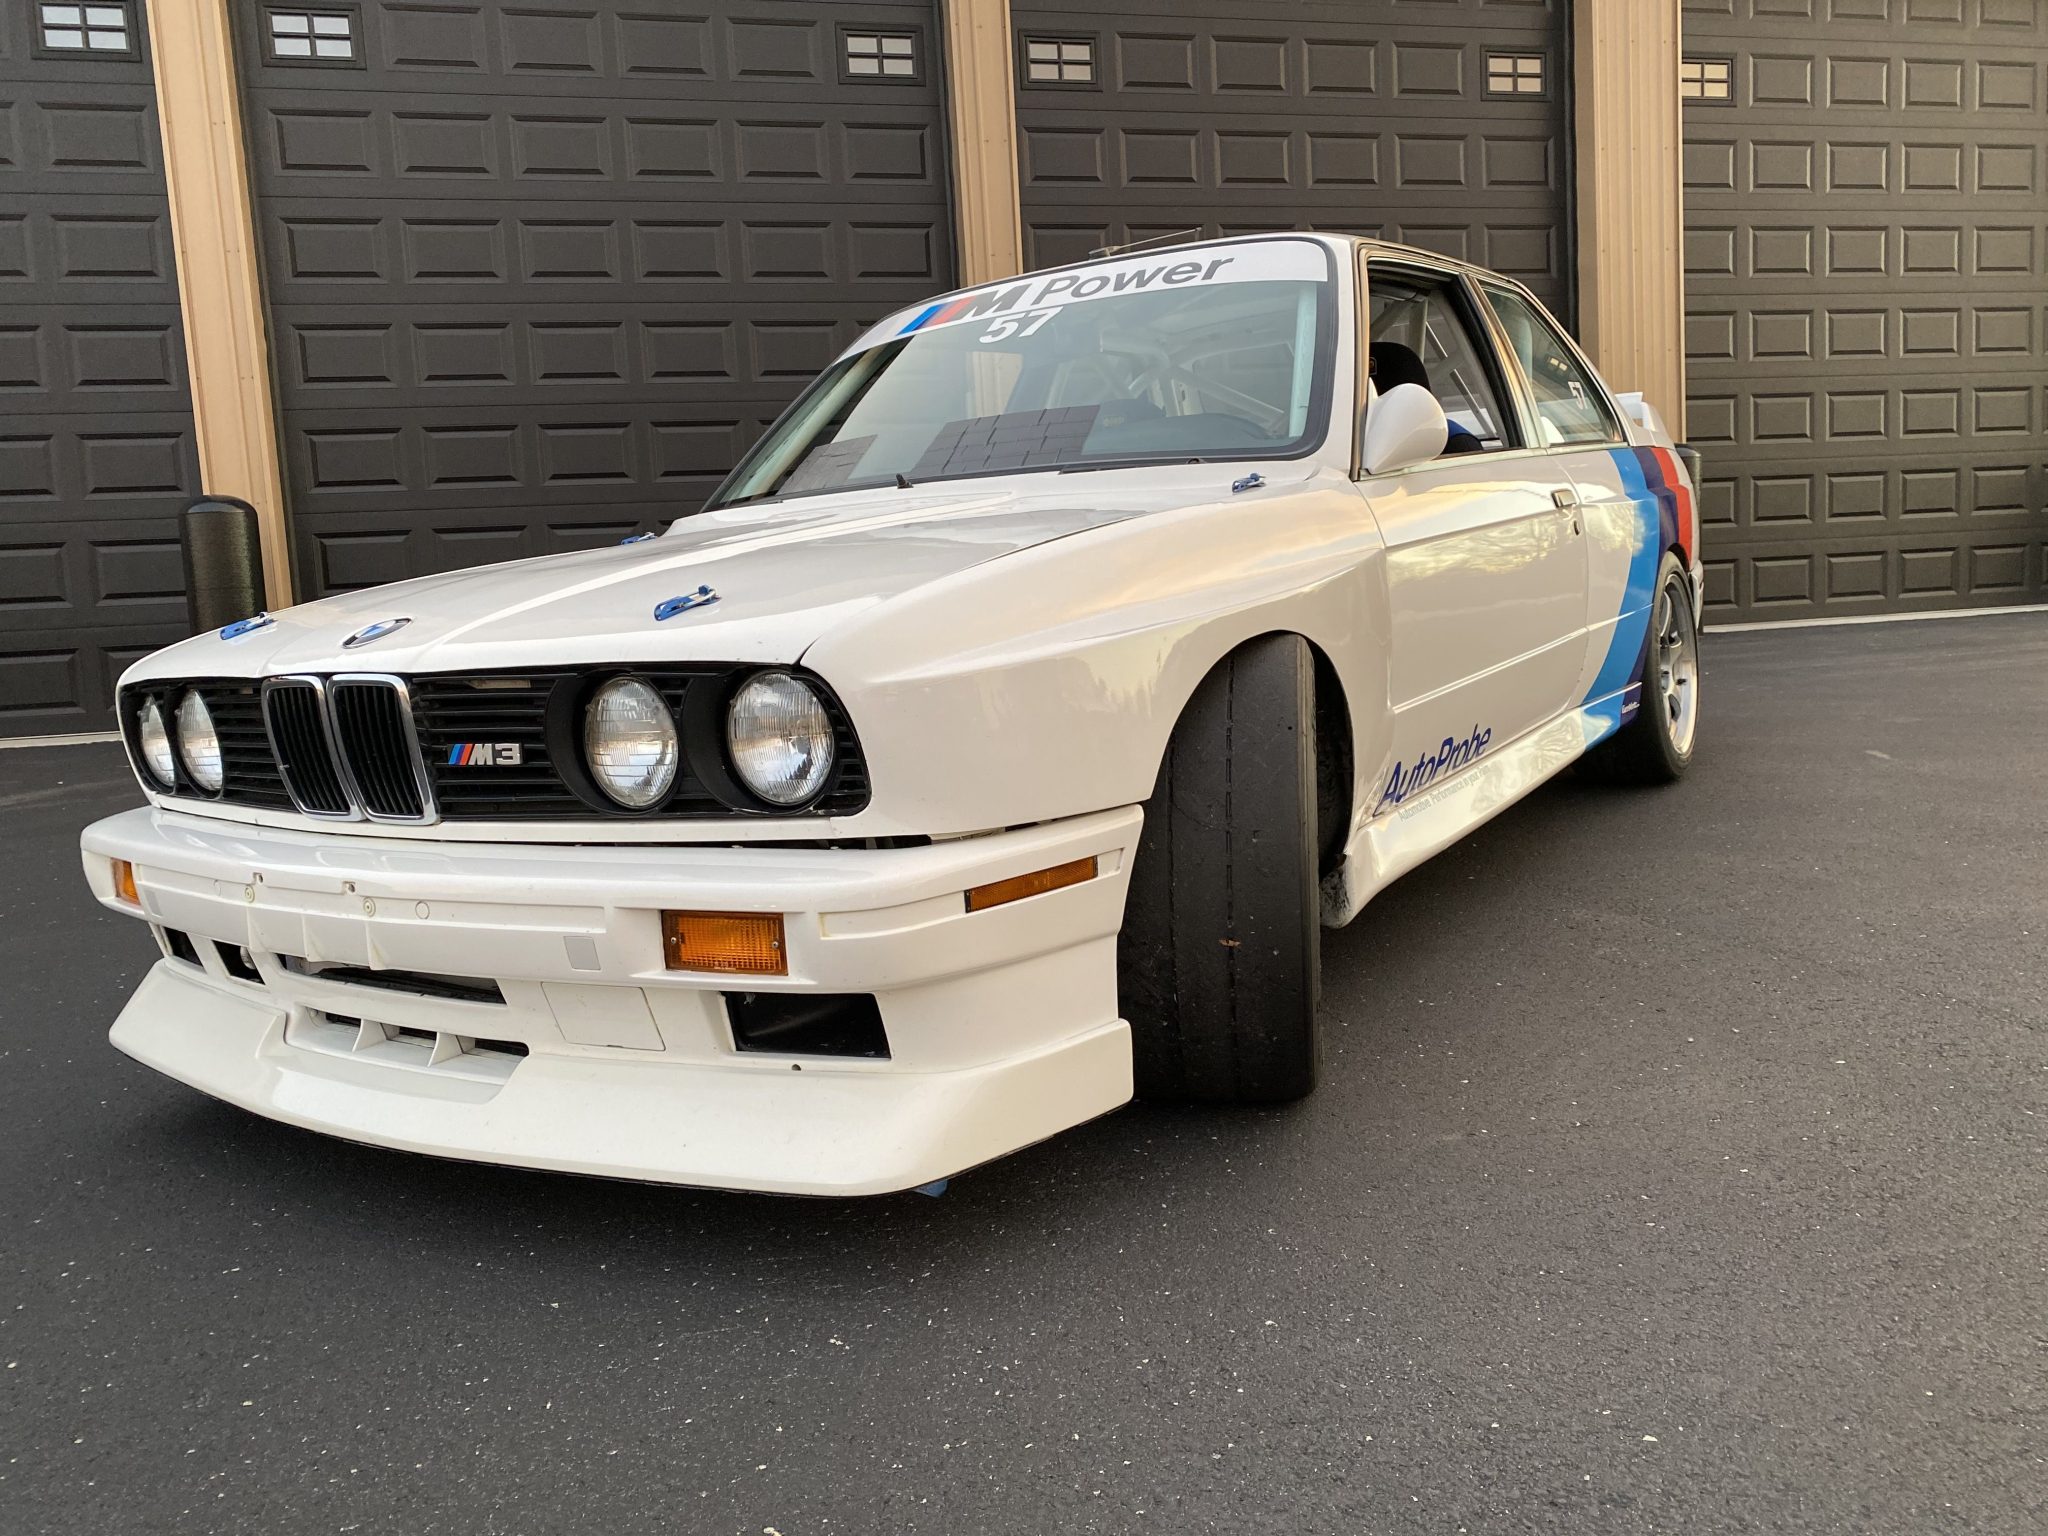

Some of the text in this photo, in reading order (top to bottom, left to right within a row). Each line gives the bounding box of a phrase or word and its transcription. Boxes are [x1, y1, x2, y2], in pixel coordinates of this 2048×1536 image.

[979, 306, 1063, 344] 57
[1567, 381, 1589, 410] 57
[467, 743, 521, 766] M3
[1372, 723, 1492, 818] AutoProbe
